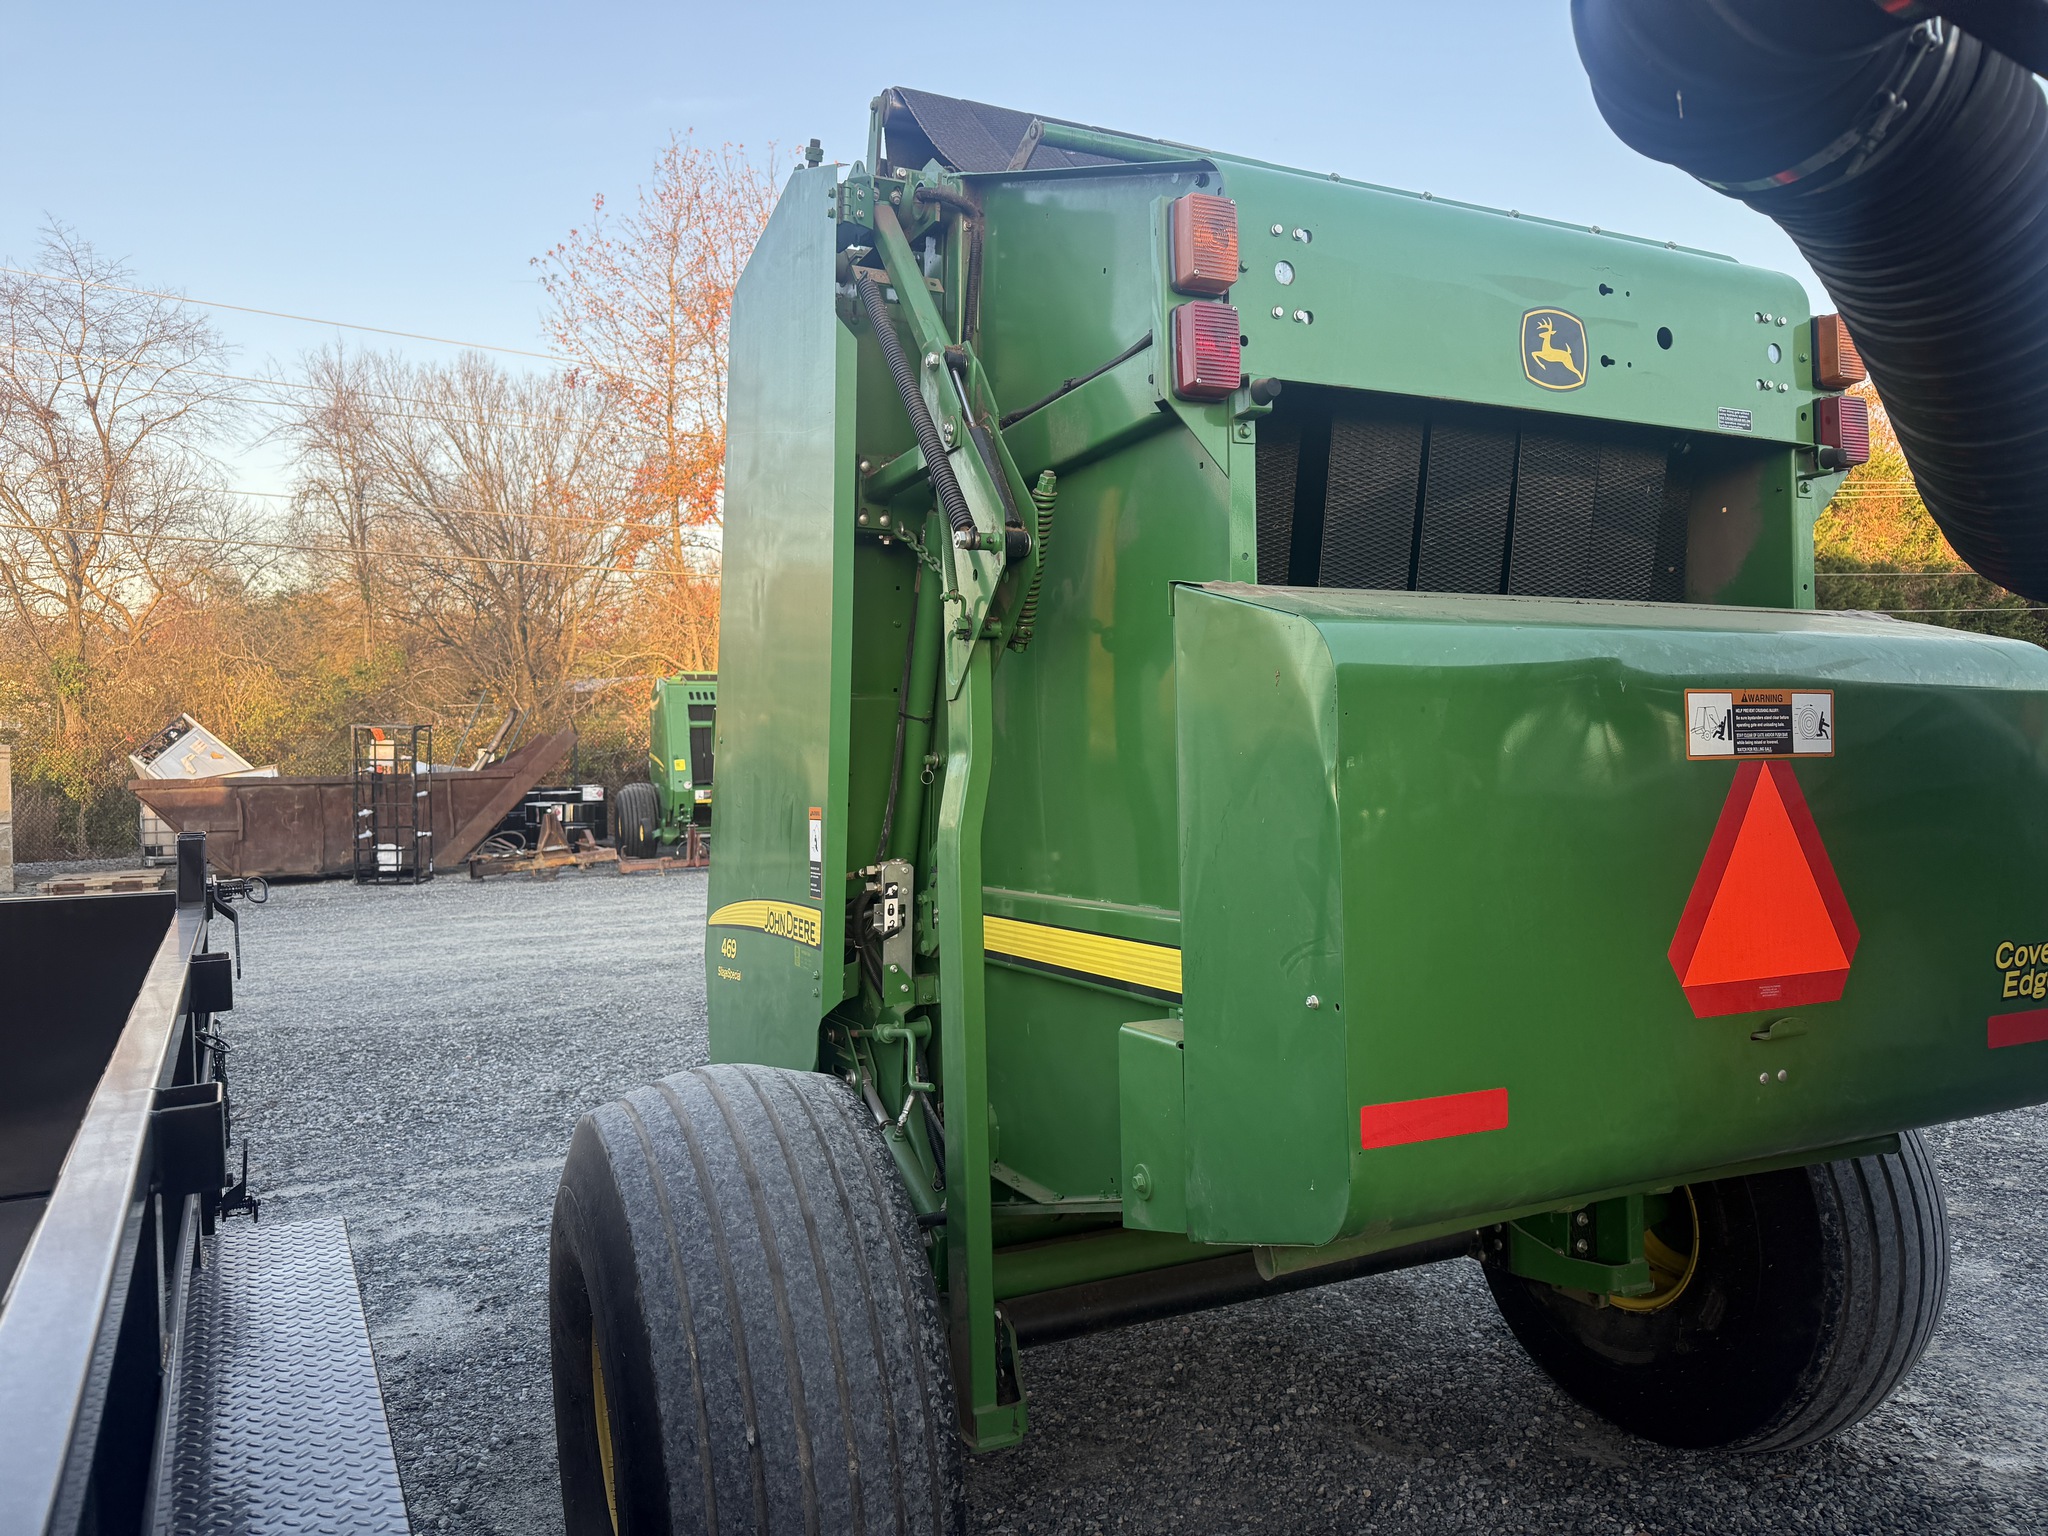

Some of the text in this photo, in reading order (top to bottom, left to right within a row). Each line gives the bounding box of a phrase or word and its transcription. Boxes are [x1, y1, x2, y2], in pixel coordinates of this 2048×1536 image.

[1747, 693, 1783, 703] WARNING
[764, 906, 817, 944] JOHN DEERE
[721, 937, 737, 959] 469
[2003, 968, 2048, 999] Edg
